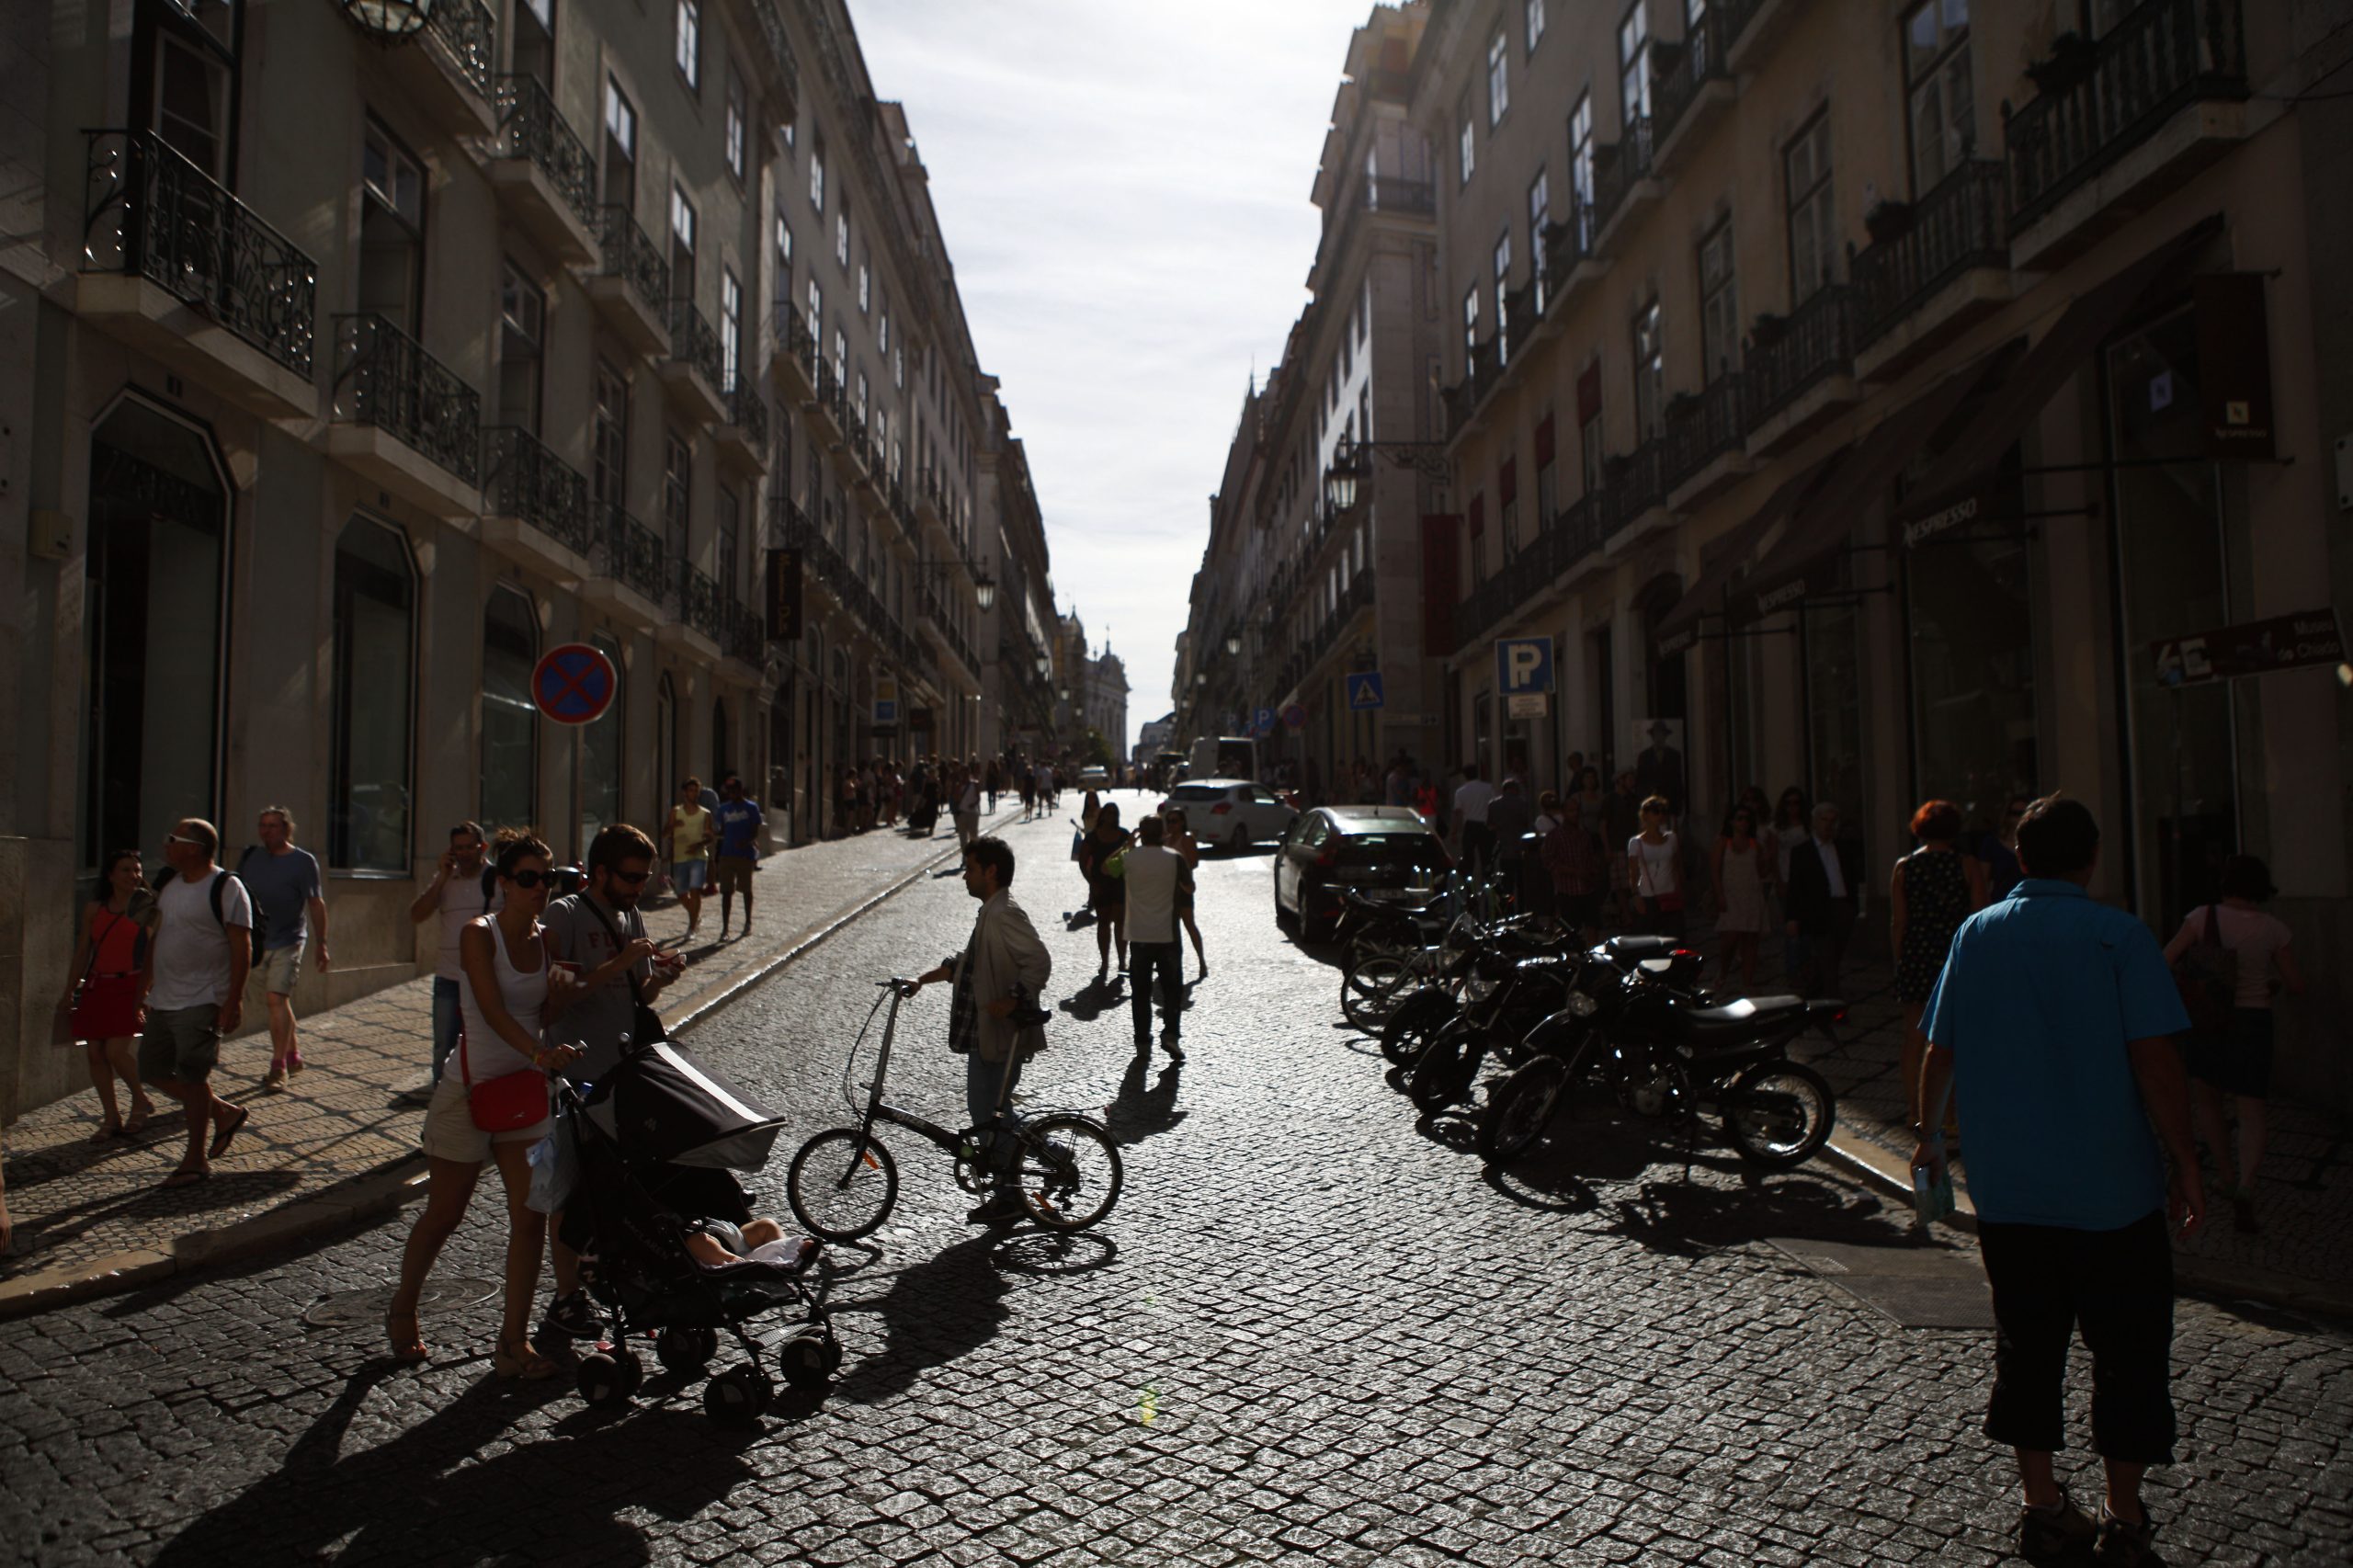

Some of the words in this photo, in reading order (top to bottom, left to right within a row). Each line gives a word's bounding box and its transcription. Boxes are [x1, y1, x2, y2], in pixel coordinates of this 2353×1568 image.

[1903, 496, 1978, 549] NESPRESSO
[1756, 578, 1807, 616] NESPRESSO
[1507, 643, 1542, 689] P
[1257, 709, 1270, 725] P
